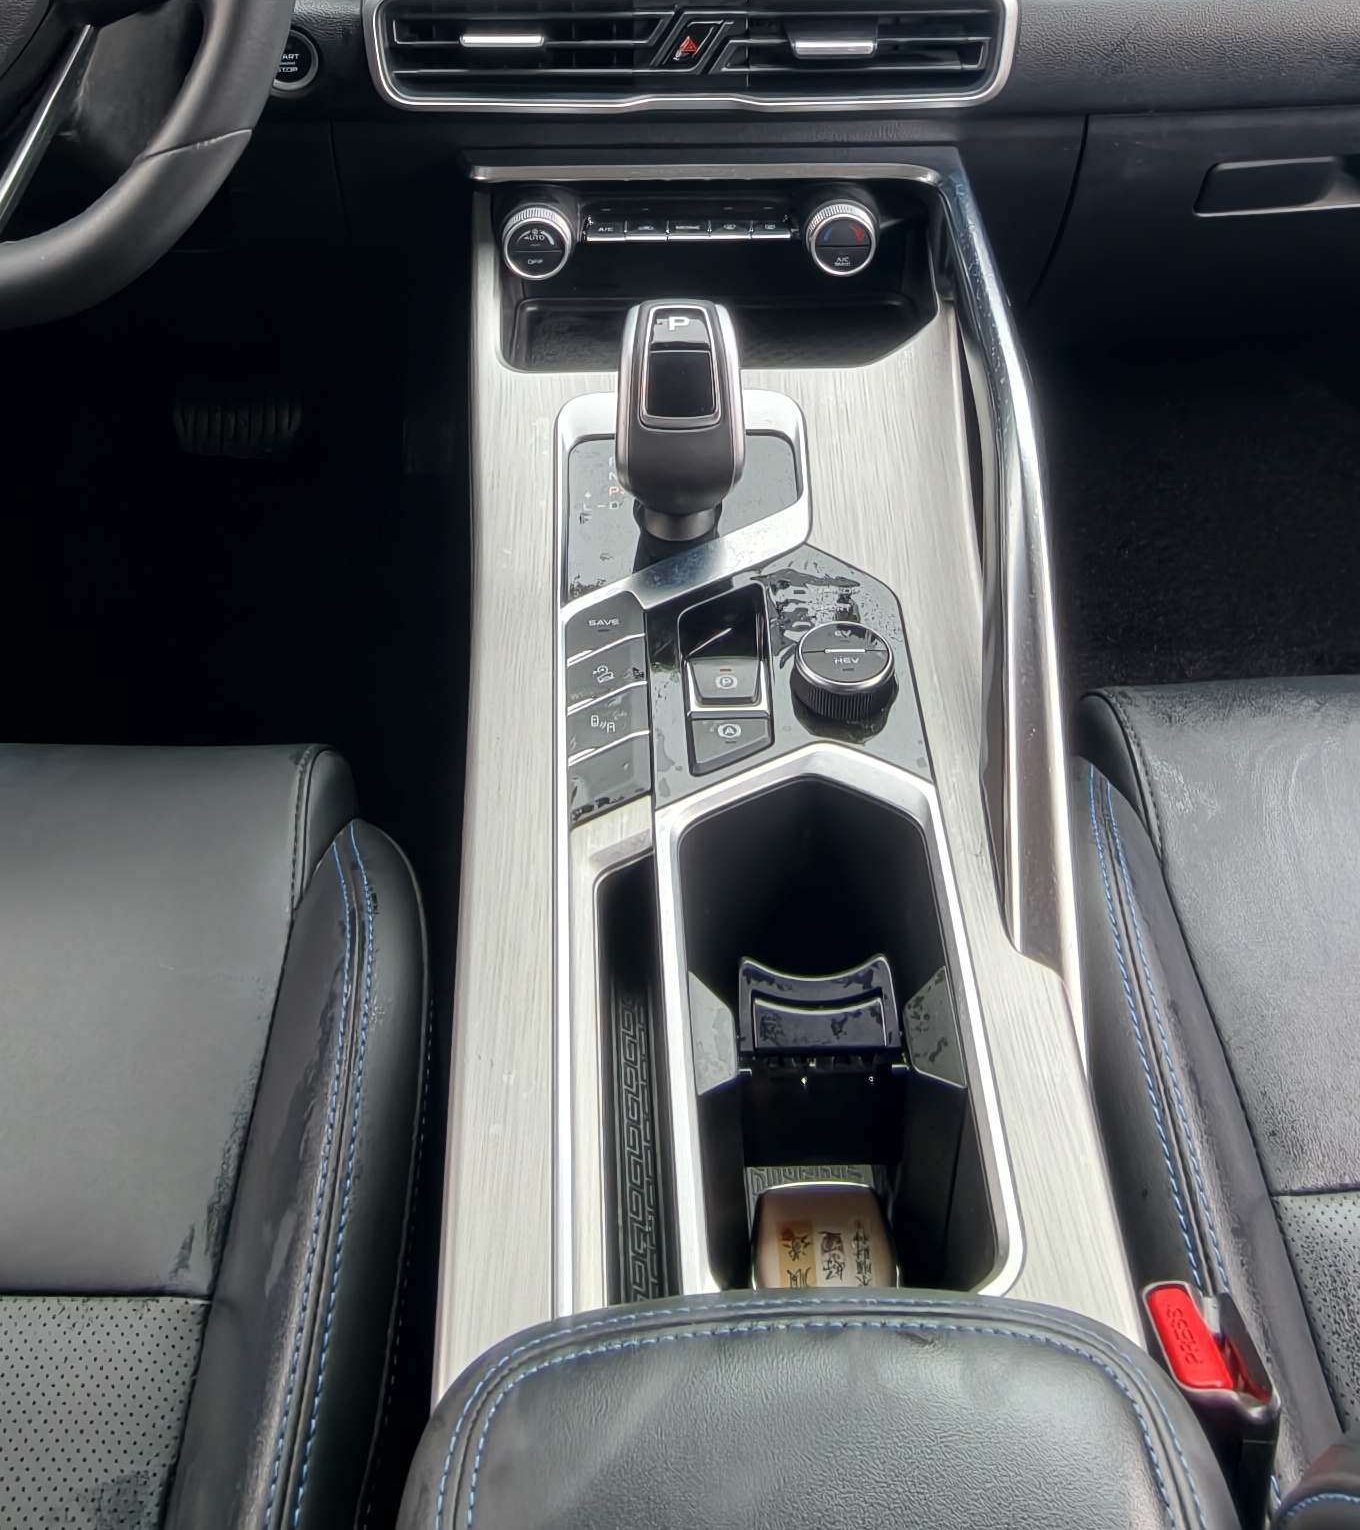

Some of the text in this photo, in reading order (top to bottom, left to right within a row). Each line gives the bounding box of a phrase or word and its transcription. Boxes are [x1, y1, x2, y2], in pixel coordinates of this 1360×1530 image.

[669, 316, 690, 331] P
[588, 618, 620, 627] SAVE
[833, 657, 860, 665] HEV
